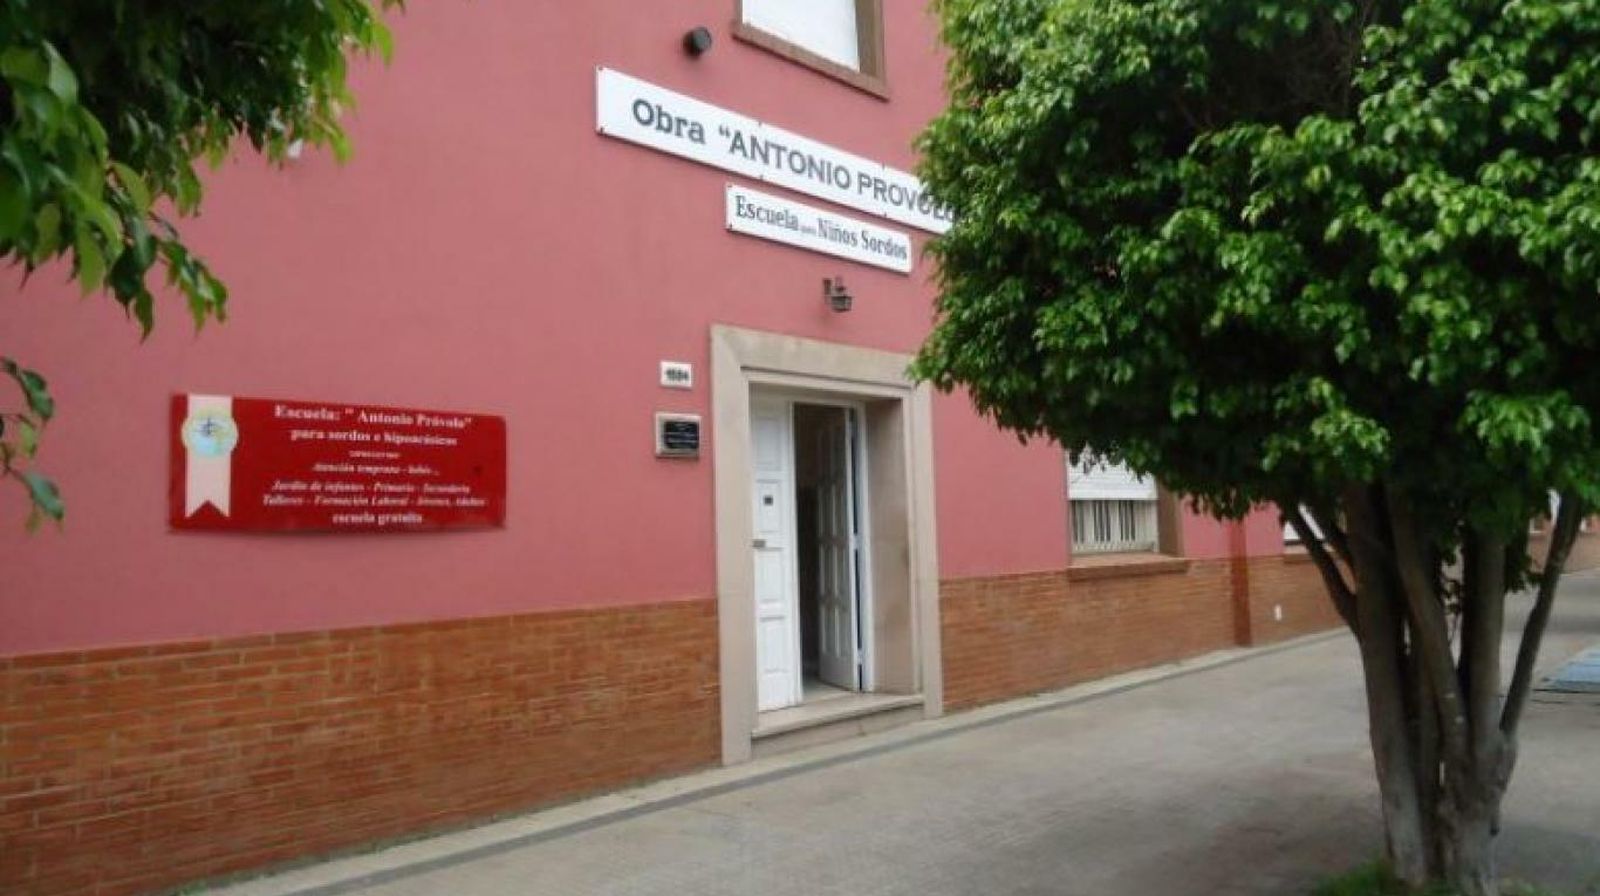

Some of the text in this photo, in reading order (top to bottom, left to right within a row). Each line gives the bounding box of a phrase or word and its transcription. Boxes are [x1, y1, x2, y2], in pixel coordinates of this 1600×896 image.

[632, 99, 706, 145] Obra
[735, 195, 798, 231] Escuela
[817, 217, 858, 247] Niños
[861, 230, 908, 260] Sordos
[274, 403, 340, 421] Escuela:
[358, 410, 414, 425] Antonio
[290, 429, 324, 441] para
[328, 429, 371, 443] sordos
[333, 511, 422, 526] escuela gratuita
